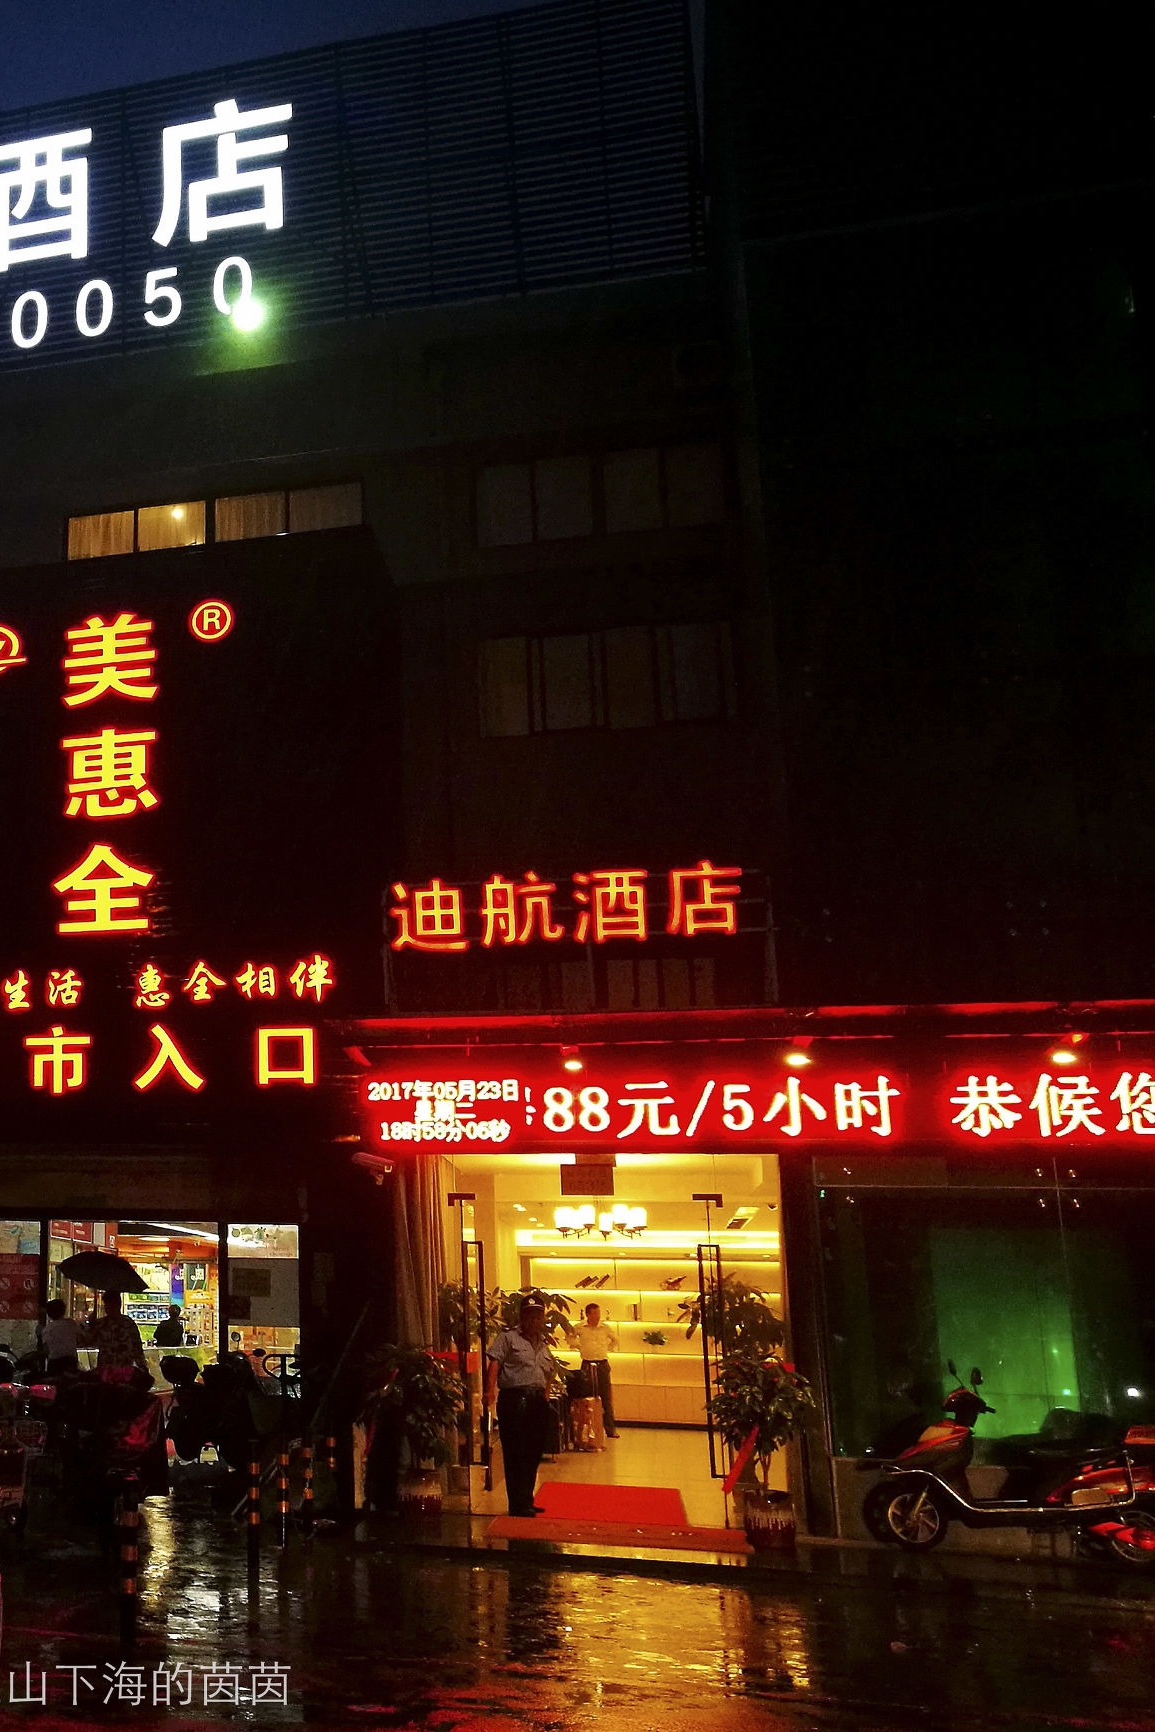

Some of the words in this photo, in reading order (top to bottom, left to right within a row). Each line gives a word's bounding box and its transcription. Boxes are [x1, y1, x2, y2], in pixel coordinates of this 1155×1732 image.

[53, 613, 158, 933] 美惠全
[392, 860, 741, 953] 迪航酒店
[135, 954, 334, 1008] 惠全相伴
[368, 1079, 519, 1102] 2017年05月23日
[414, 1098, 476, 1121] 星期二
